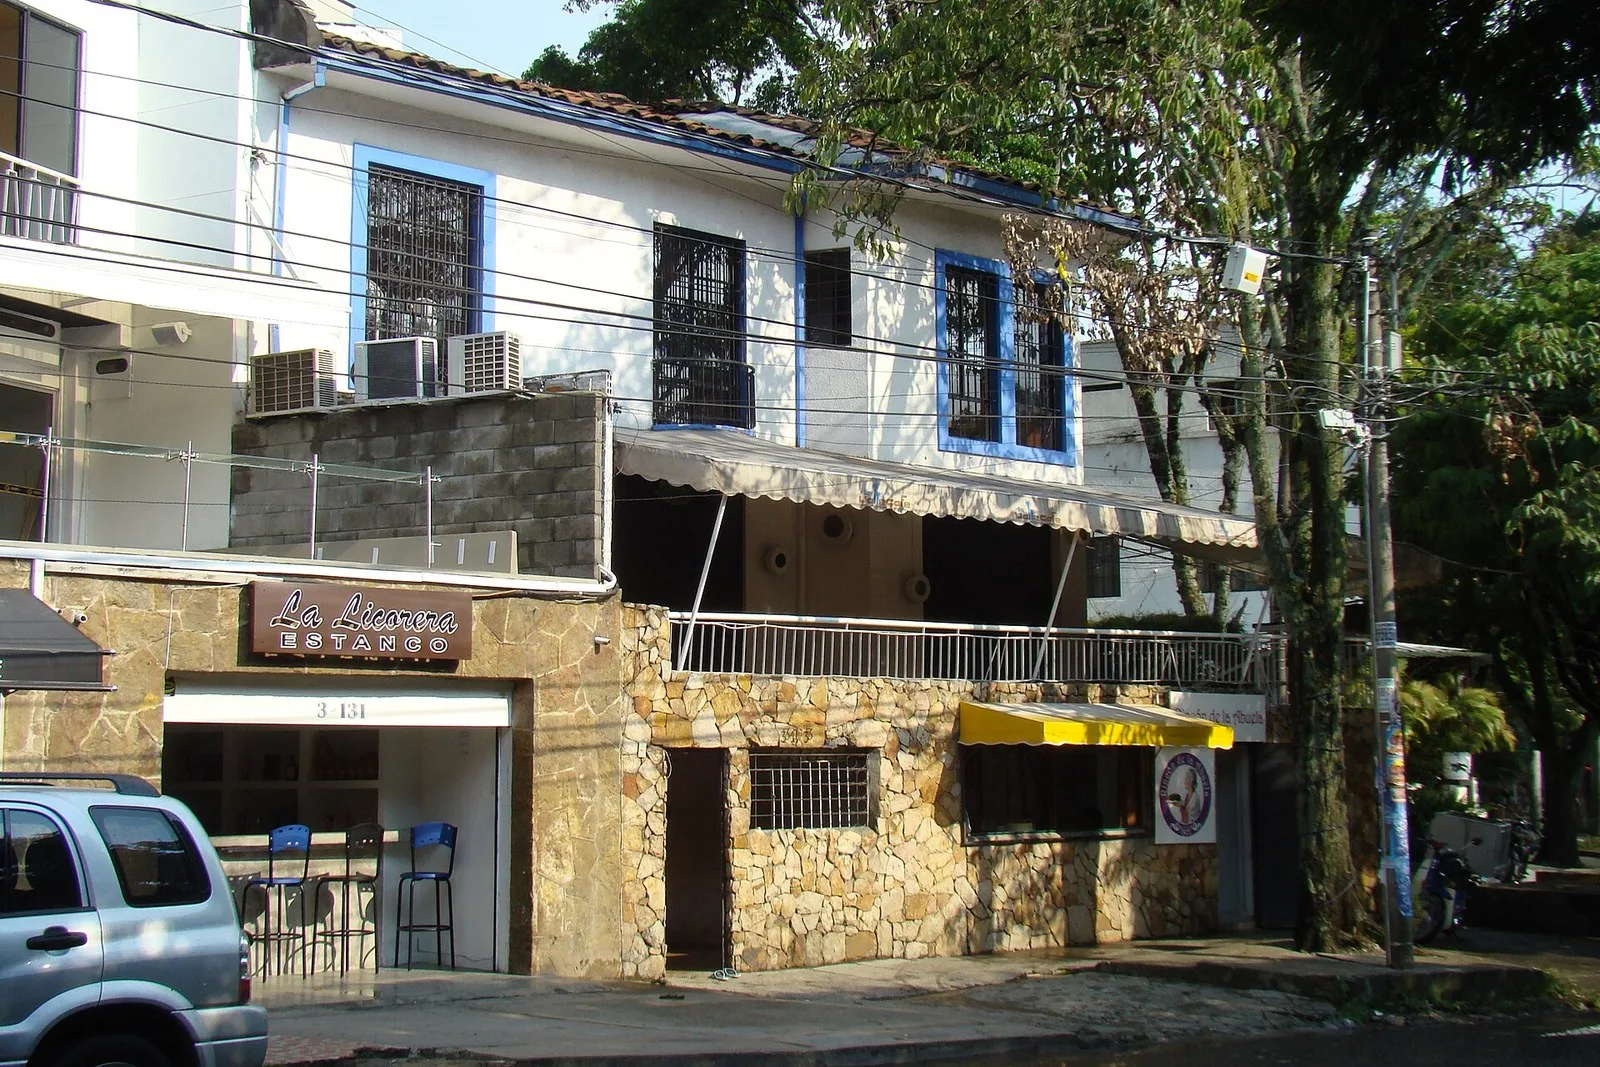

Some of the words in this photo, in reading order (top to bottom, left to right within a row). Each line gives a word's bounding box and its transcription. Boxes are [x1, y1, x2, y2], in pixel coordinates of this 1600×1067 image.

[270, 589, 323, 629] La
[332, 592, 458, 634] Licorera
[280, 632, 449, 653] ESTANCO
